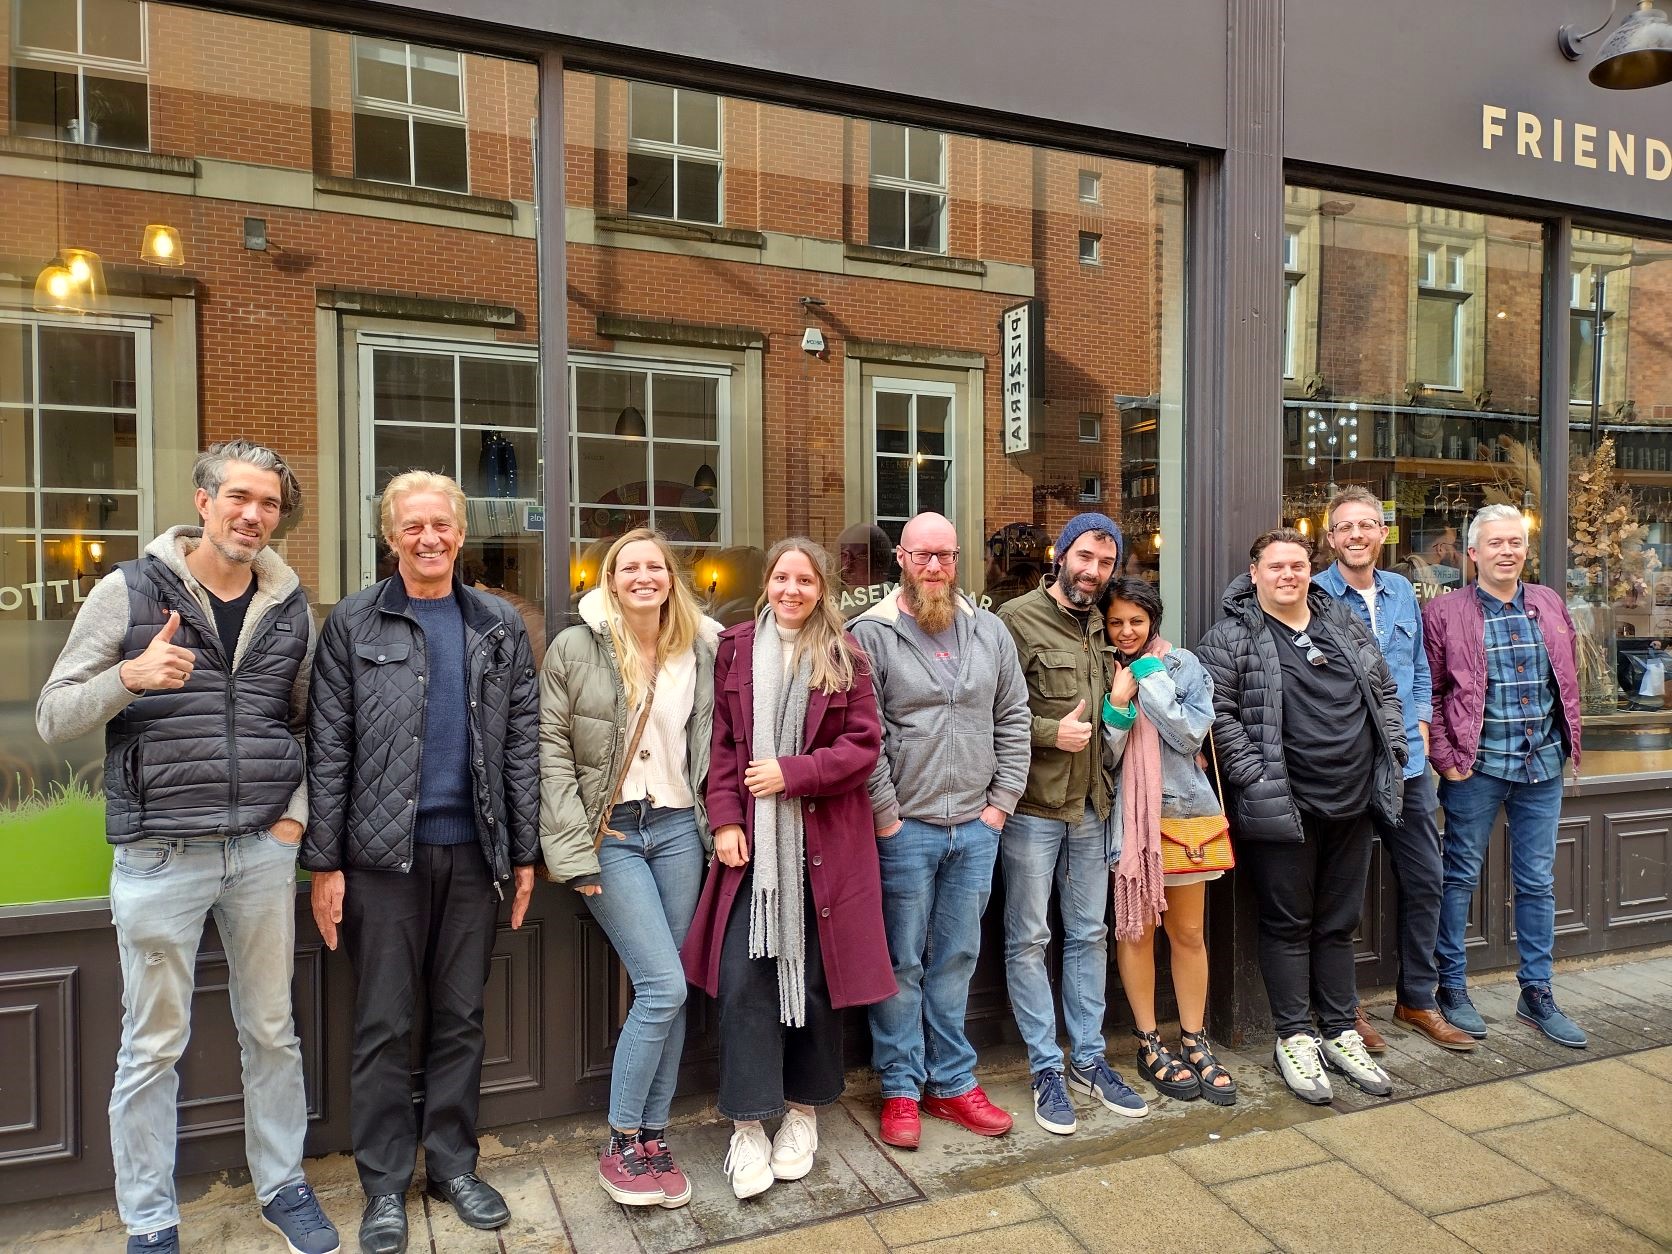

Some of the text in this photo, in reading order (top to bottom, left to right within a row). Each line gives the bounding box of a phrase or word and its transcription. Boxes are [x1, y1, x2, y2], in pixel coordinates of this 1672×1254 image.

[1483, 104, 1672, 181] FRIEND
[0, 579, 104, 611] OTTL
[829, 583, 900, 611] BASEM
[1413, 582, 1439, 599] EW
